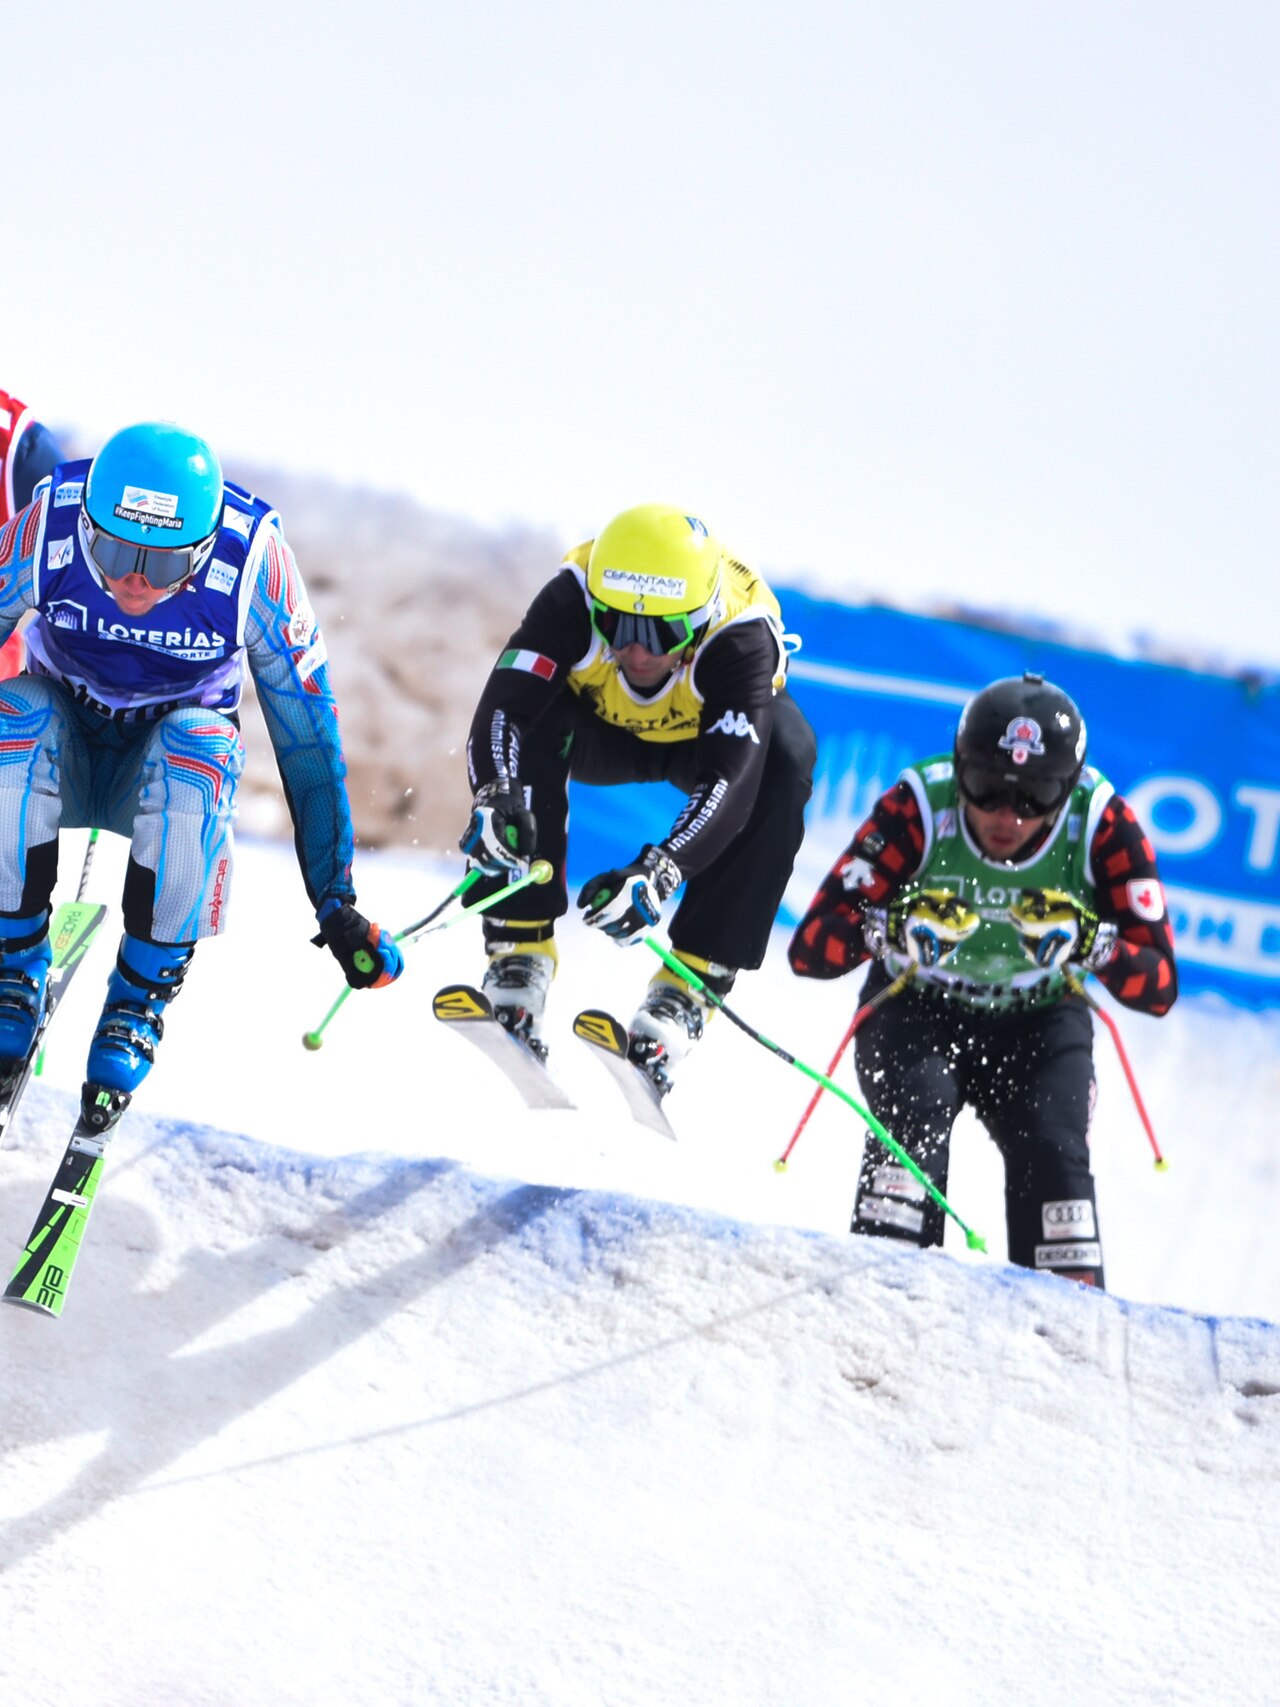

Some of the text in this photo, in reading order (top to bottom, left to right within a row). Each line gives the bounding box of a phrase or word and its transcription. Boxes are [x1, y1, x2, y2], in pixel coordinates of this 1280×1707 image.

[114, 505, 182, 529] #KeepFightingMaria
[97, 617, 226, 648] LOTERÍAS
[668, 779, 729, 852] intimissimi
[209, 859, 228, 936] stayer
